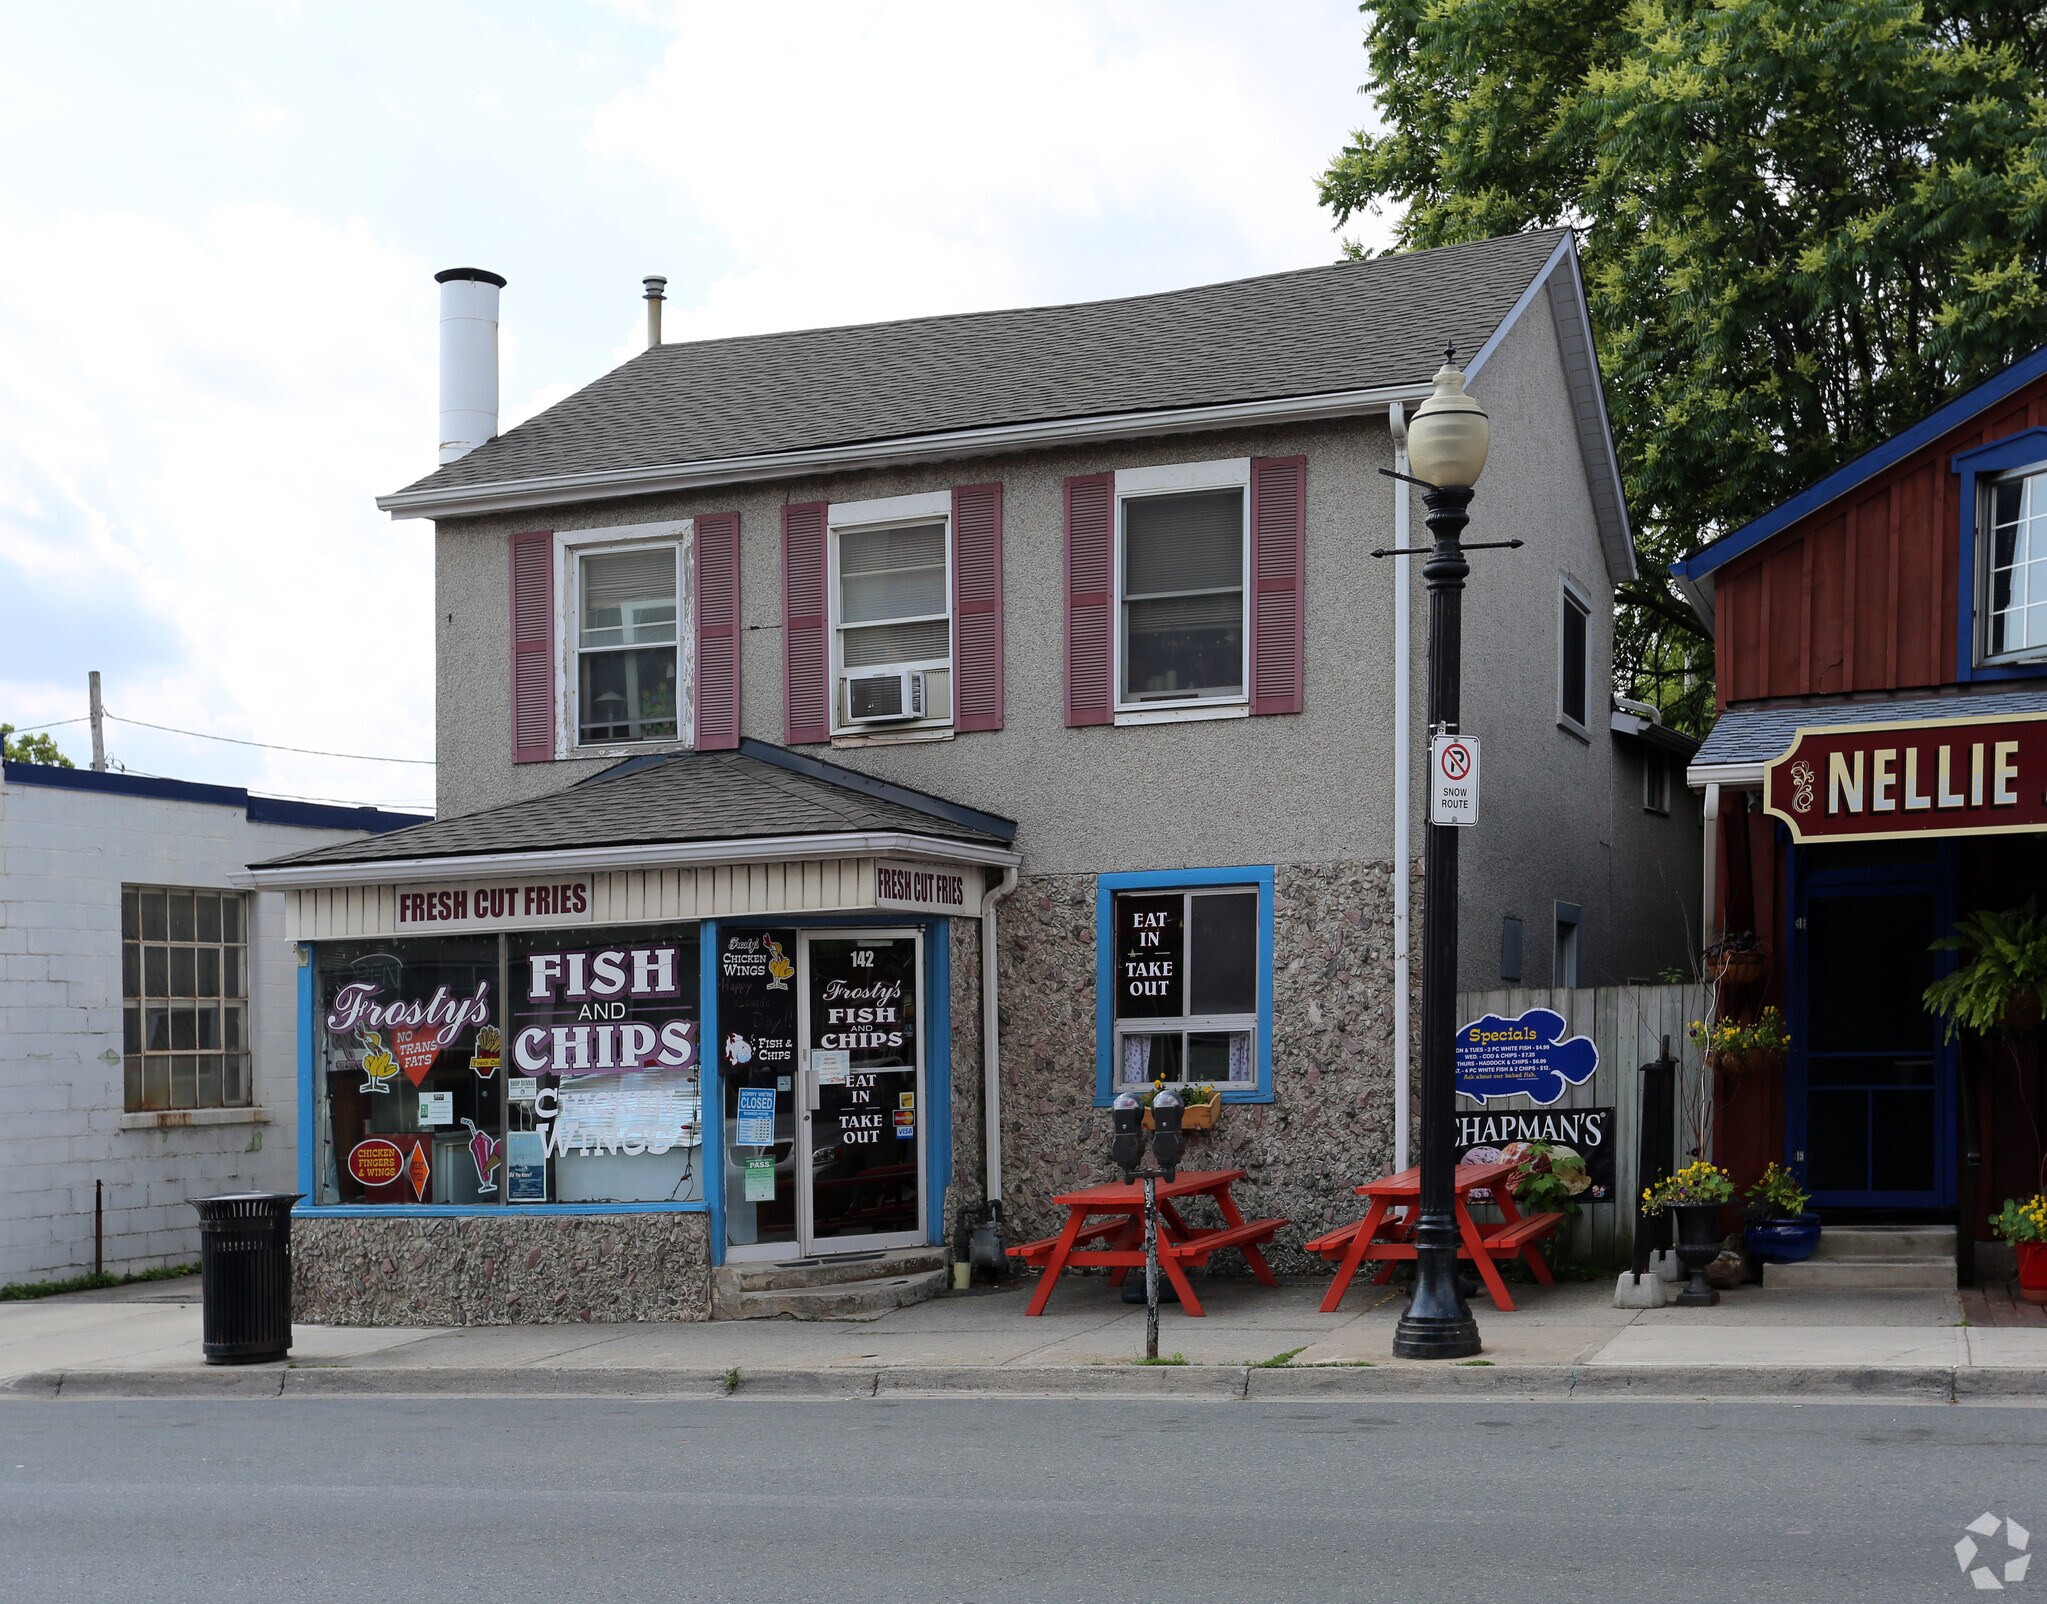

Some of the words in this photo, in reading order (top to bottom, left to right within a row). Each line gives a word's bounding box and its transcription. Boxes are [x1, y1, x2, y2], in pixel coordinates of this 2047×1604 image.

[1828, 740, 2019, 814] NELLIE
[1443, 787, 1468, 797] SNOW
[1441, 799, 1469, 809] ROUTE
[878, 867, 912, 901] FRESH
[914, 871, 935, 903] CUT
[936, 874, 964, 906] FRIES
[400, 890, 468, 923] FRESH
[474, 887, 520, 920] CUT
[524, 883, 588, 917] FRIES
[1133, 912, 1168, 928] EAT
[1139, 932, 1160, 947] IN
[723, 953, 767, 964] CHICKEN
[850, 951, 874, 968] 142
[529, 948, 676, 998] FISH
[723, 964, 766, 977] WINGS
[1125, 962, 1174, 978] TAKE
[822, 979, 901, 1007] Frosty's
[1129, 981, 1170, 997] OUT
[327, 981, 487, 1045] Frosty's
[578, 1002, 626, 1021] AND
[828, 1007, 896, 1024] FISH
[397, 1031, 412, 1043] NO
[759, 1038, 785, 1049] FISH
[786, 1039, 793, 1048] &
[821, 1032, 903, 1049] CHIPS
[1469, 1027, 1537, 1045] Specials
[400, 1040, 438, 1055] TRANS
[514, 1020, 693, 1072] CHIPS
[404, 1054, 432, 1068] FATS
[759, 1050, 791, 1062] CHIPS
[845, 1075, 876, 1087] EAT
[535, 1087, 674, 1119] CHICKEN
[740, 1097, 773, 1109] CLOSED
[852, 1091, 870, 1103] IN
[839, 1115, 882, 1128] TAKE
[537, 1122, 676, 1158] WINGS
[843, 1130, 879, 1144] OUT
[358, 1149, 395, 1158] CHICKEN
[359, 1158, 395, 1168] FINGERS
[359, 1169, 365, 1177] &
[367, 1168, 396, 1177] WINGS
